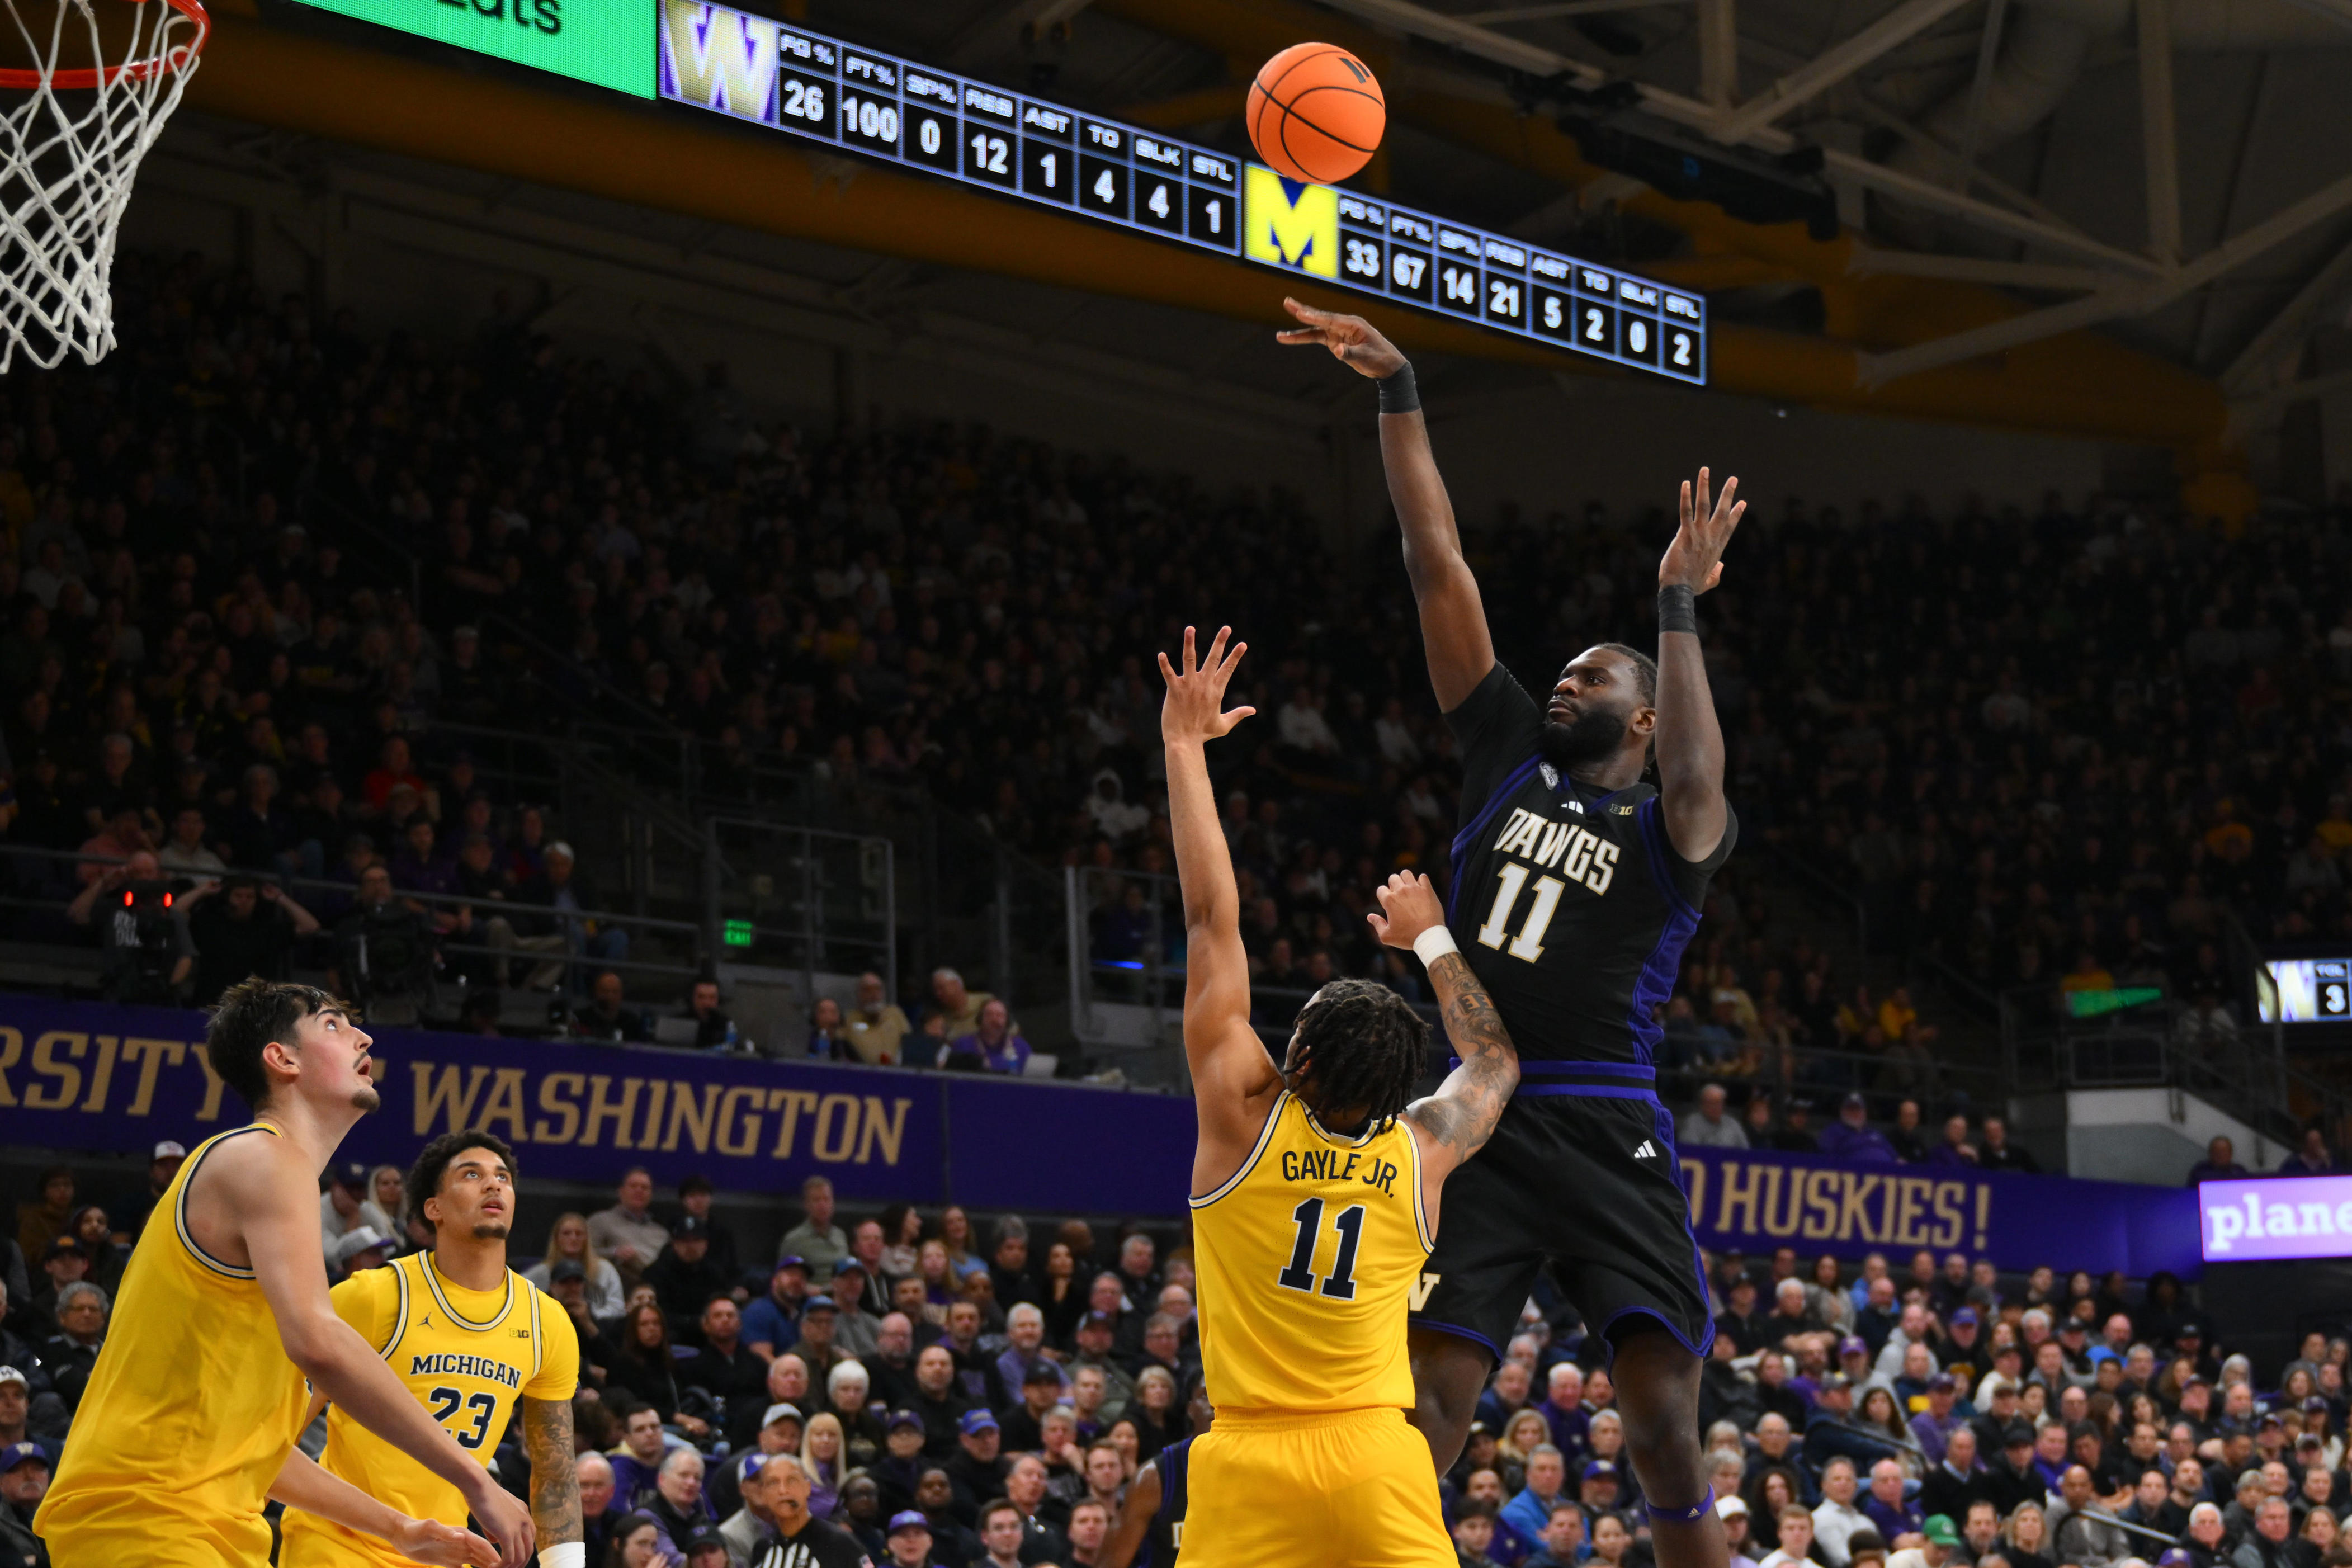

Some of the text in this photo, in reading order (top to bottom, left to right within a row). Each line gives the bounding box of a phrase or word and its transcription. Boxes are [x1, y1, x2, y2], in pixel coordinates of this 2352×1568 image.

[437, 0, 561, 34] ats
[784, 79, 1221, 234] 26 100 0 12 1 4 4 1
[846, 56, 895, 86] FT%
[906, 74, 957, 104] 3P%
[966, 89, 1013, 117] REB
[1023, 107, 1070, 133] AST
[1088, 125, 1119, 148] TO
[1136, 139, 1180, 166] BLK
[1193, 155, 1234, 182] STL
[1247, 162, 1338, 277] M
[1345, 239, 1691, 366] 33 67 14 21 5 2 0 2
[1391, 216, 1433, 242] FT%
[1439, 230, 1480, 256] 3P%
[1485, 241, 1526, 267] REB
[1531, 257, 1569, 279] AST
[1583, 270, 1609, 292] TO
[1620, 281, 1656, 306] BLK
[1666, 295, 1699, 319] STL
[1493, 807, 1620, 896] DAWGS
[1478, 861, 1565, 963] 11
[2325, 984, 2346, 1013] 3
[411, 1061, 912, 1165] WASHINGTON
[1282, 1150, 1397, 1198] GAYLE JR.
[1715, 1161, 1991, 1250] HUSKIES!
[1278, 1197, 1367, 1301] 11
[410, 1353, 521, 1390] MICHIGAN
[429, 1387, 497, 1449] 23
[15, 1442, 34, 1456] W
